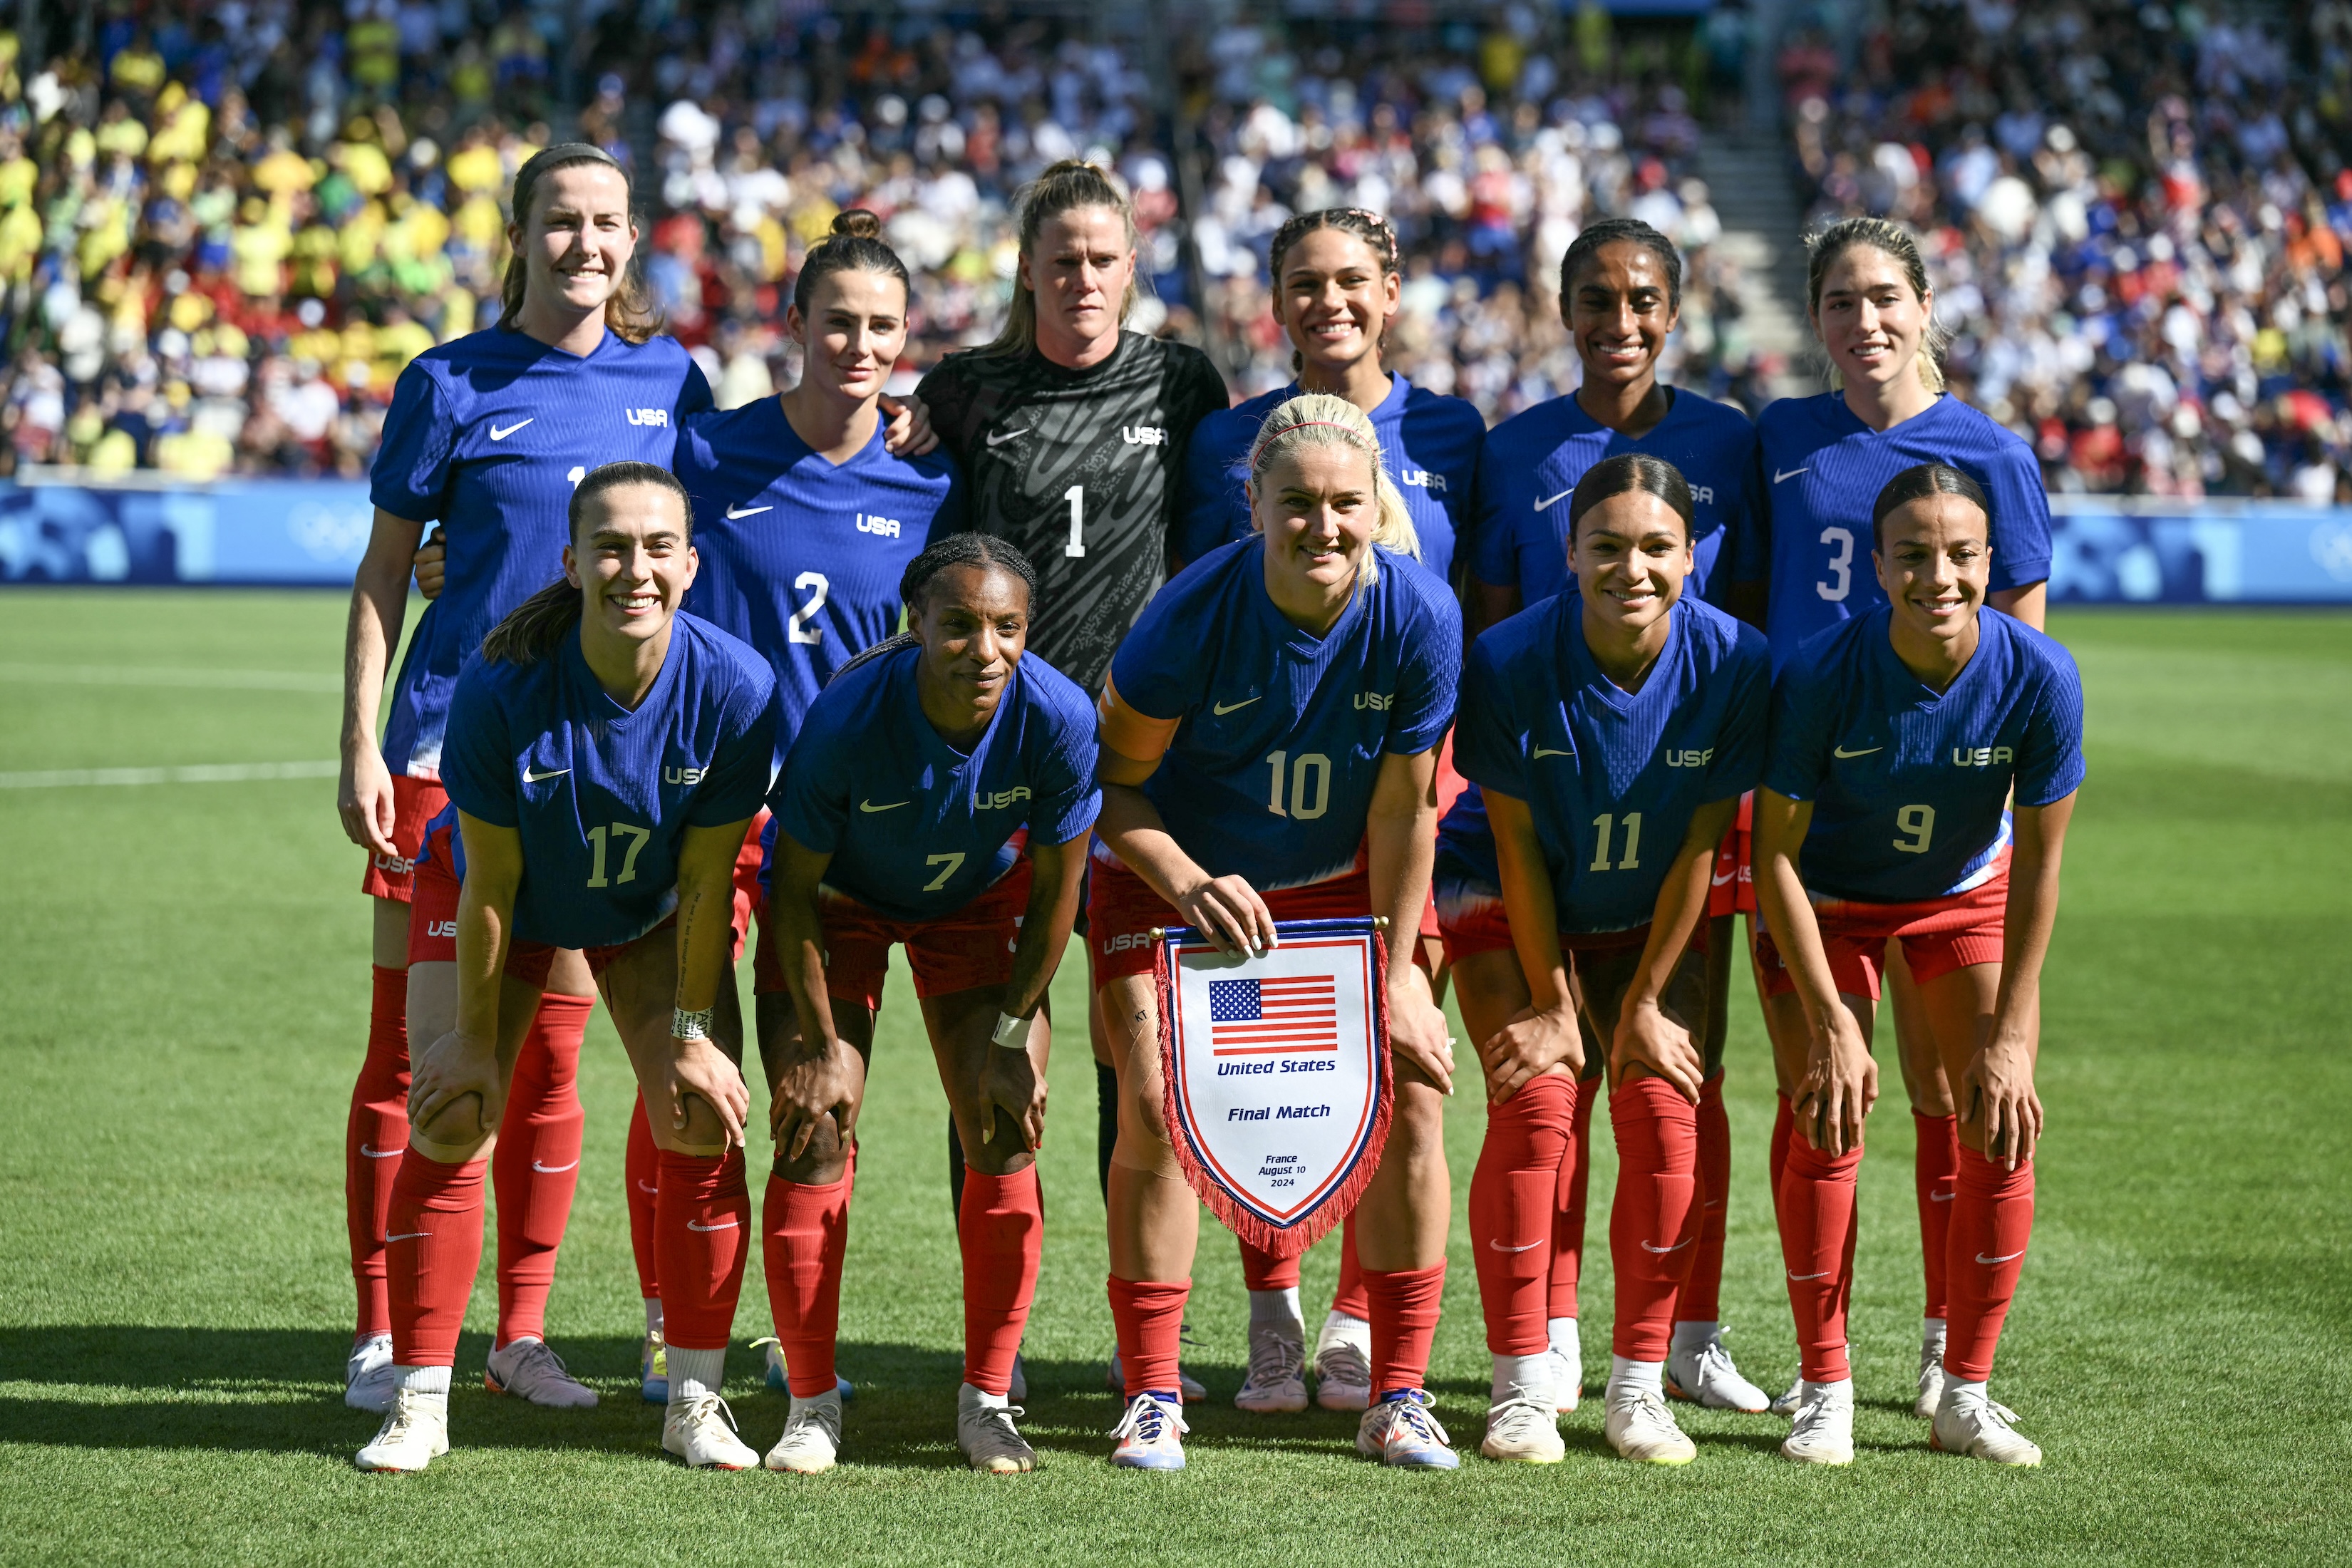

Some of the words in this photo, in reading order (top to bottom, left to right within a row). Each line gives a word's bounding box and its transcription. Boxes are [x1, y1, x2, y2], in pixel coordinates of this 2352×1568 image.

[626, 408, 668, 428] USA
[1123, 426, 1169, 446] USA
[1401, 469, 1448, 492] USA
[856, 512, 901, 539] USA
[1064, 485, 1085, 557] 1
[1816, 526, 1854, 602] 3
[788, 571, 829, 645] 2
[1953, 746, 2013, 767] USA
[1266, 750, 1331, 820] 10
[974, 786, 1031, 810] USA
[1892, 804, 1936, 854] 9
[1589, 812, 1642, 872] 11
[587, 821, 651, 888] 17
[923, 852, 966, 892] 7
[1104, 932, 1150, 955] USA
[1135, 1010, 1147, 1022] KT
[1217, 1061, 1275, 1076] United
[1279, 1059, 1336, 1073] States
[1228, 1107, 1271, 1121] Final
[1276, 1104, 1331, 1119] Match
[1258, 1166, 1293, 1176] August
[1266, 1155, 1297, 1164] France
